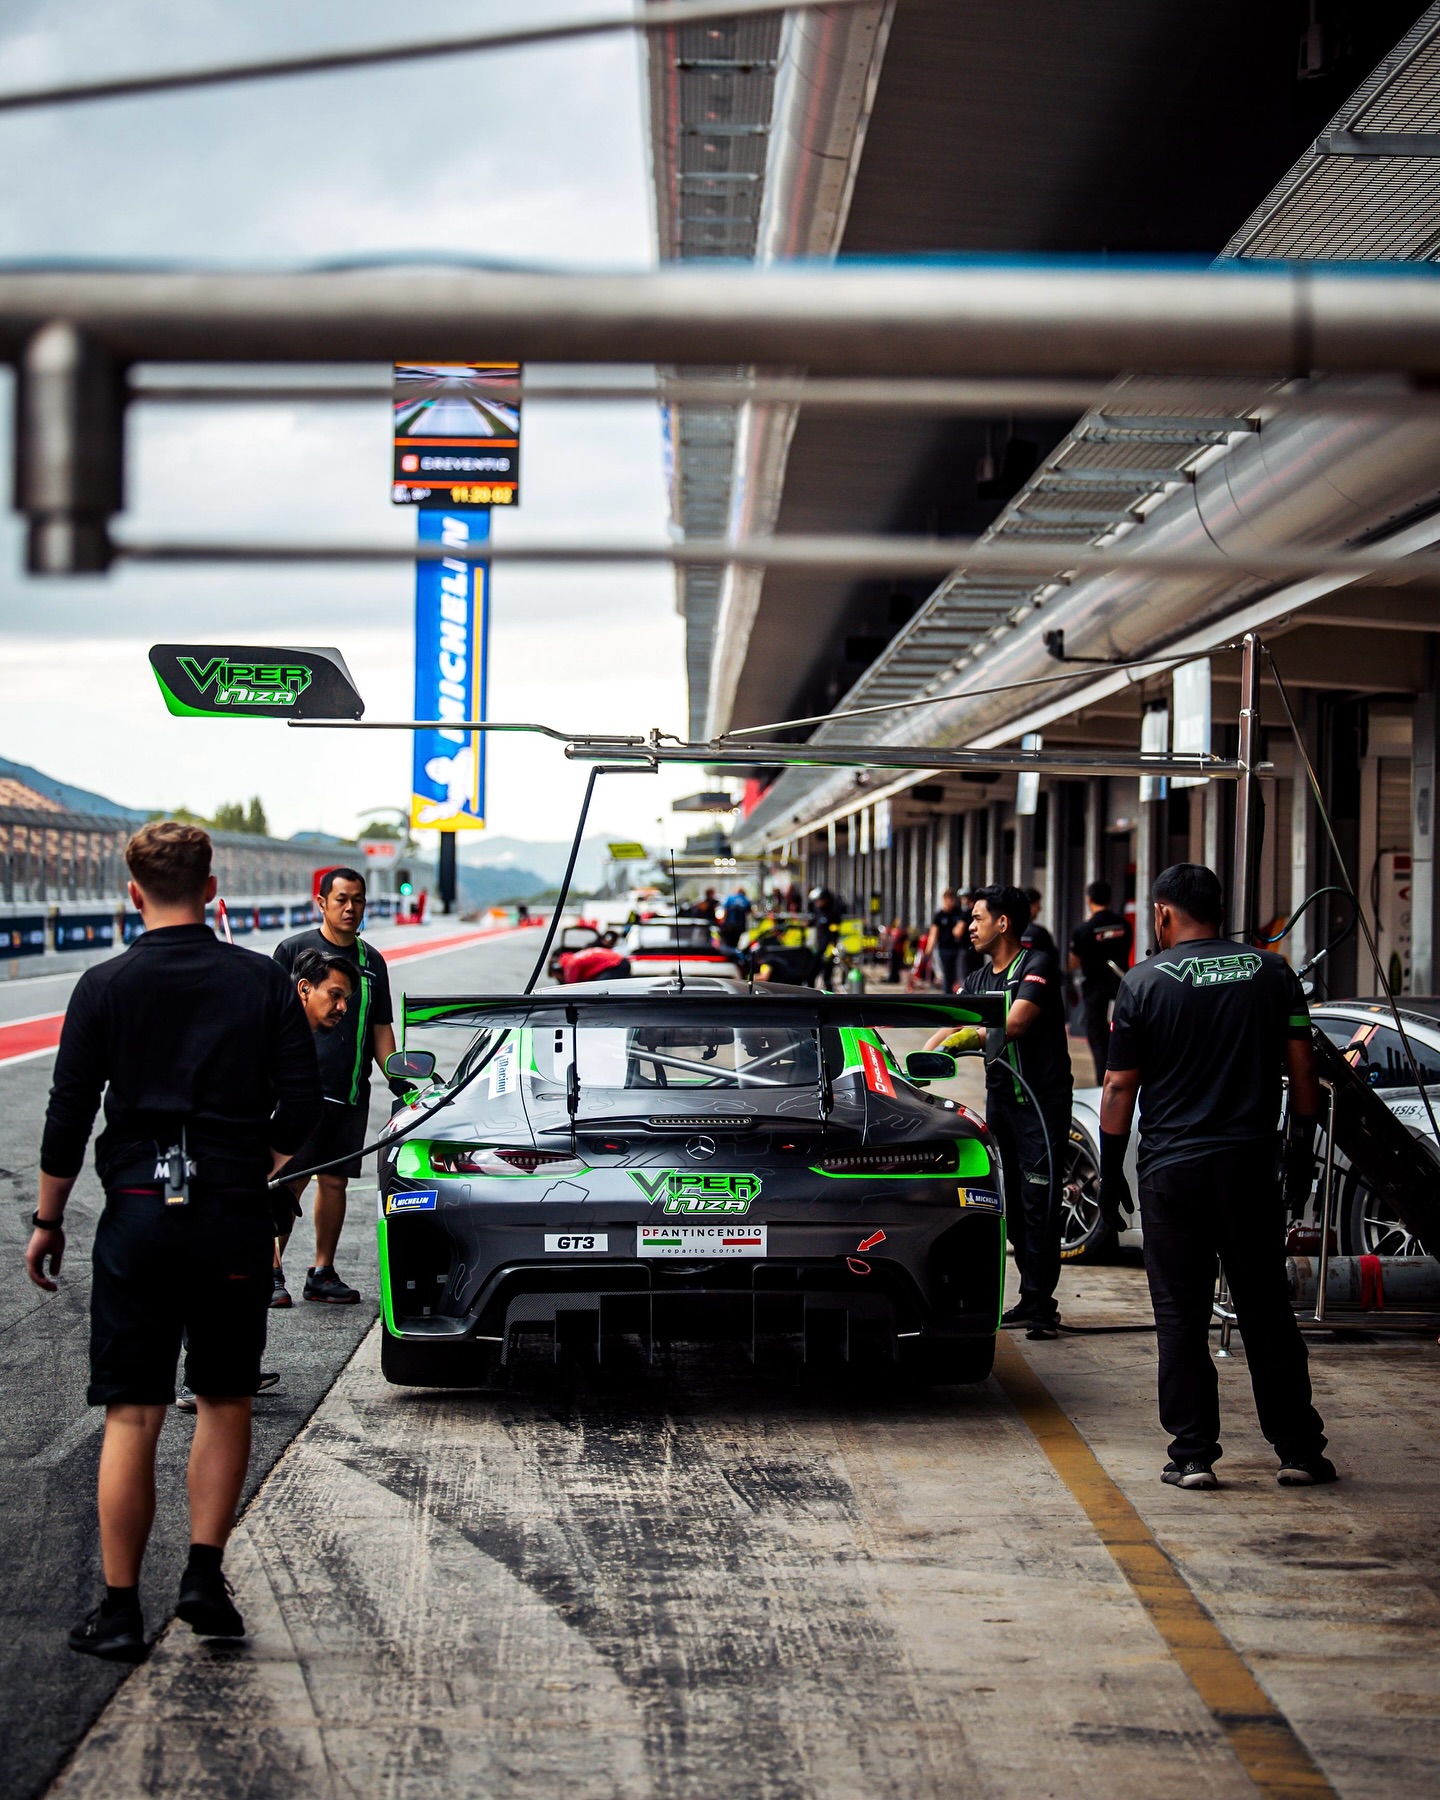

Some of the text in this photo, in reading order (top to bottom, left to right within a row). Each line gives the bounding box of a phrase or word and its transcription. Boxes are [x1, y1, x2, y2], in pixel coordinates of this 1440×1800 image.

[437, 515, 470, 744] MICHELIN
[176, 657, 313, 695] VIPER
[1154, 953, 1262, 982] VIPER
[495, 1057, 509, 1094] iRacing
[396, 1196, 430, 1207] MICHELIN
[626, 1169, 763, 1205] VIPER
[975, 1195, 999, 1205] MICHELIN
[557, 1236, 595, 1250] GT3
[642, 1228, 762, 1238] DFANTINCENDIO
